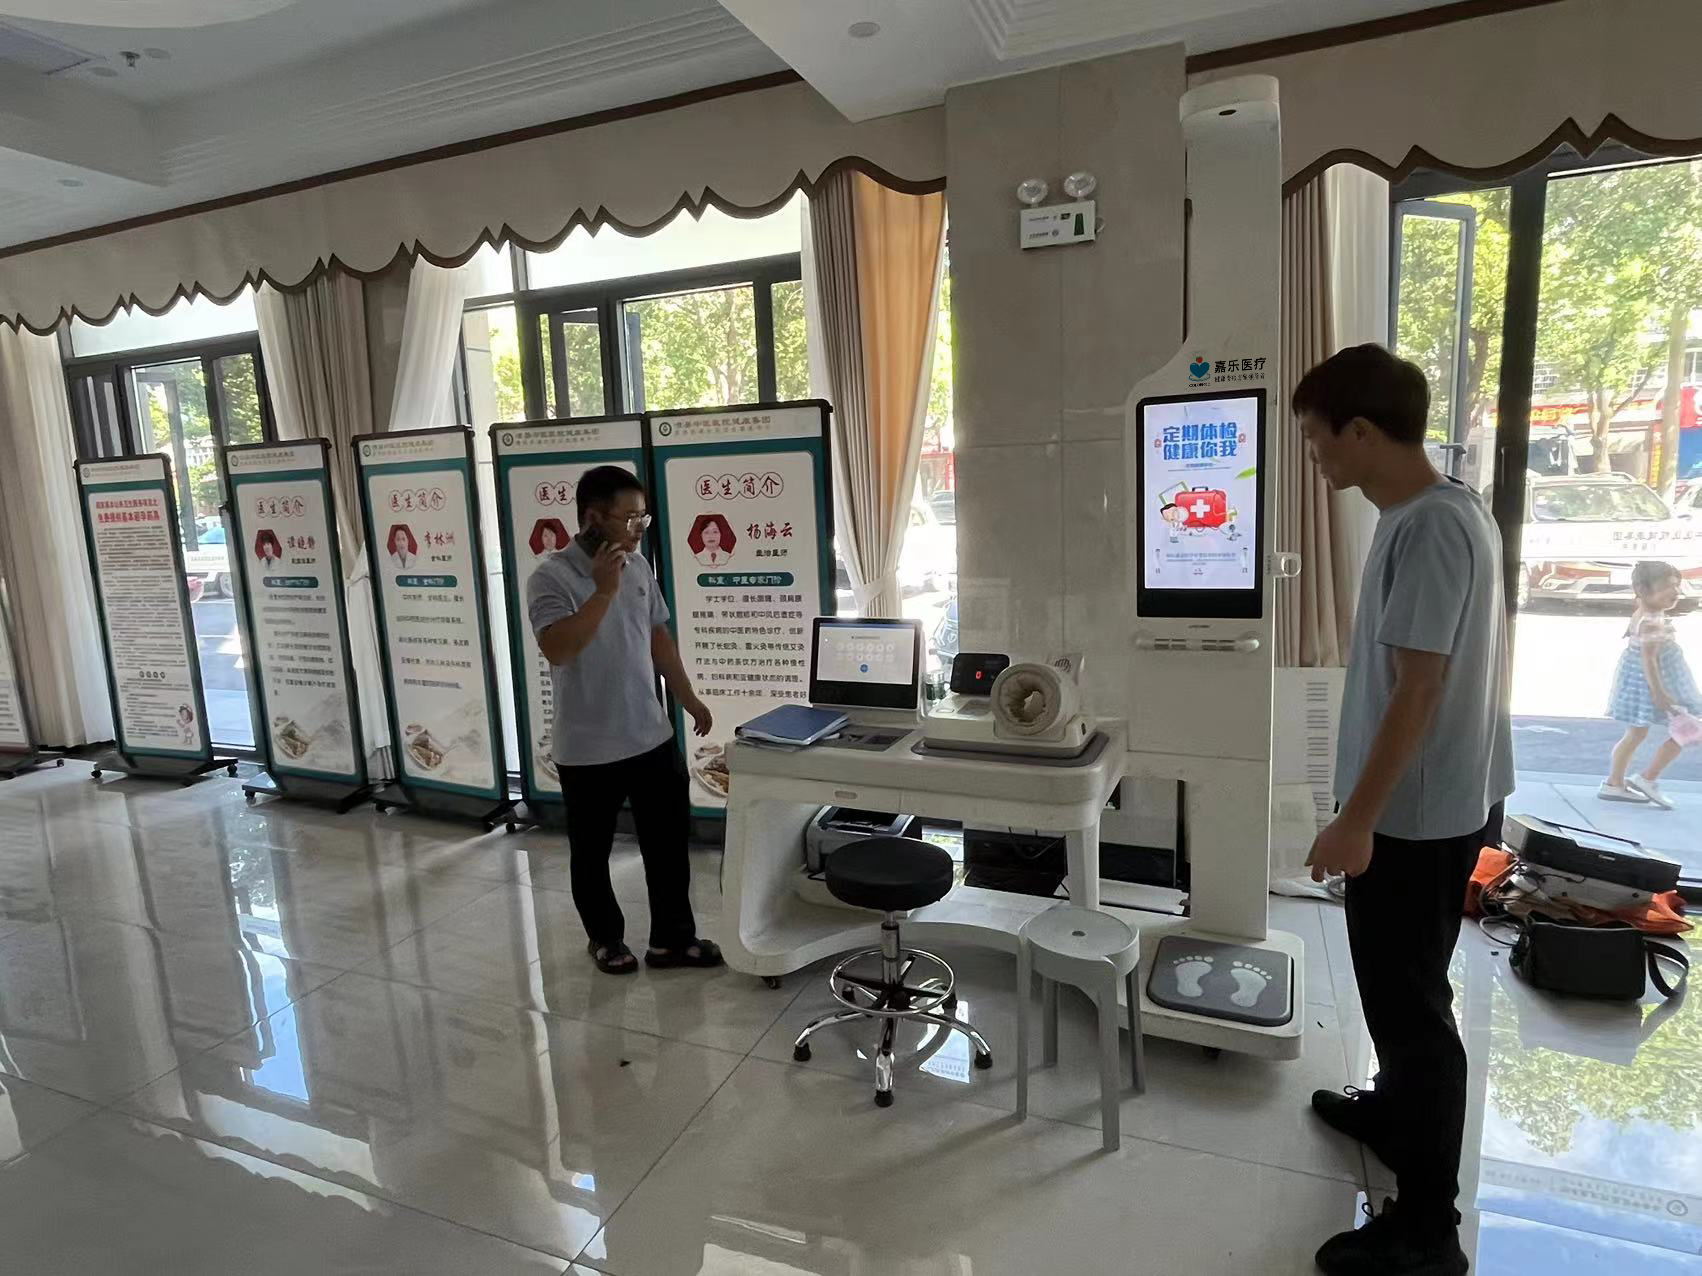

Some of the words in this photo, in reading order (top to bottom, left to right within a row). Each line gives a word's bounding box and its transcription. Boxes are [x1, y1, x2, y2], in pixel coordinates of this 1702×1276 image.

[1214, 357, 1267, 374] 嘉乐医疗
[1163, 422, 1237, 443] 定期体检
[1163, 440, 1237, 460] 健康你我
[699, 475, 780, 496] 医生简介
[391, 491, 443, 508] 医生简介
[746, 521, 793, 540] 杨海云
